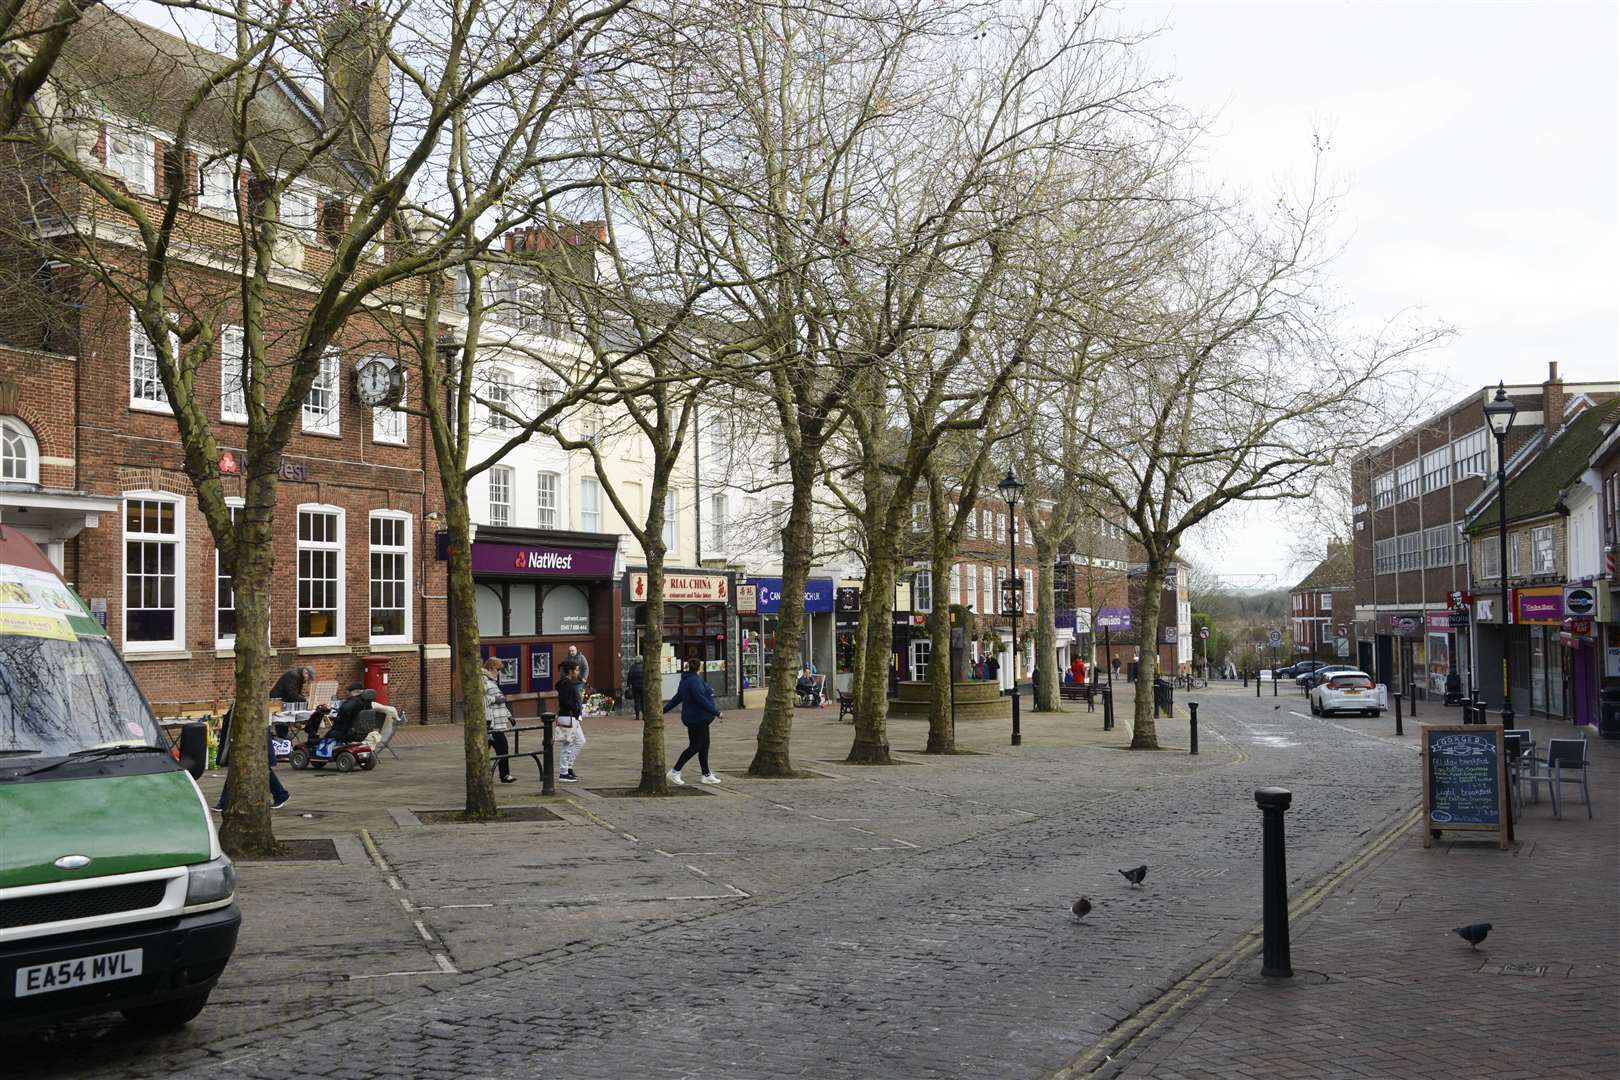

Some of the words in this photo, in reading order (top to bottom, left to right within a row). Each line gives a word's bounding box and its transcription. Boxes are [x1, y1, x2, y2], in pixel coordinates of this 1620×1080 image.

[528, 552, 572, 569] NatWest
[689, 578, 711, 590] CHINA
[769, 592, 781, 600] CAN
[813, 592, 820, 600] UK
[27, 960, 86, 991] EA54
[92, 953, 133, 979] MVL
